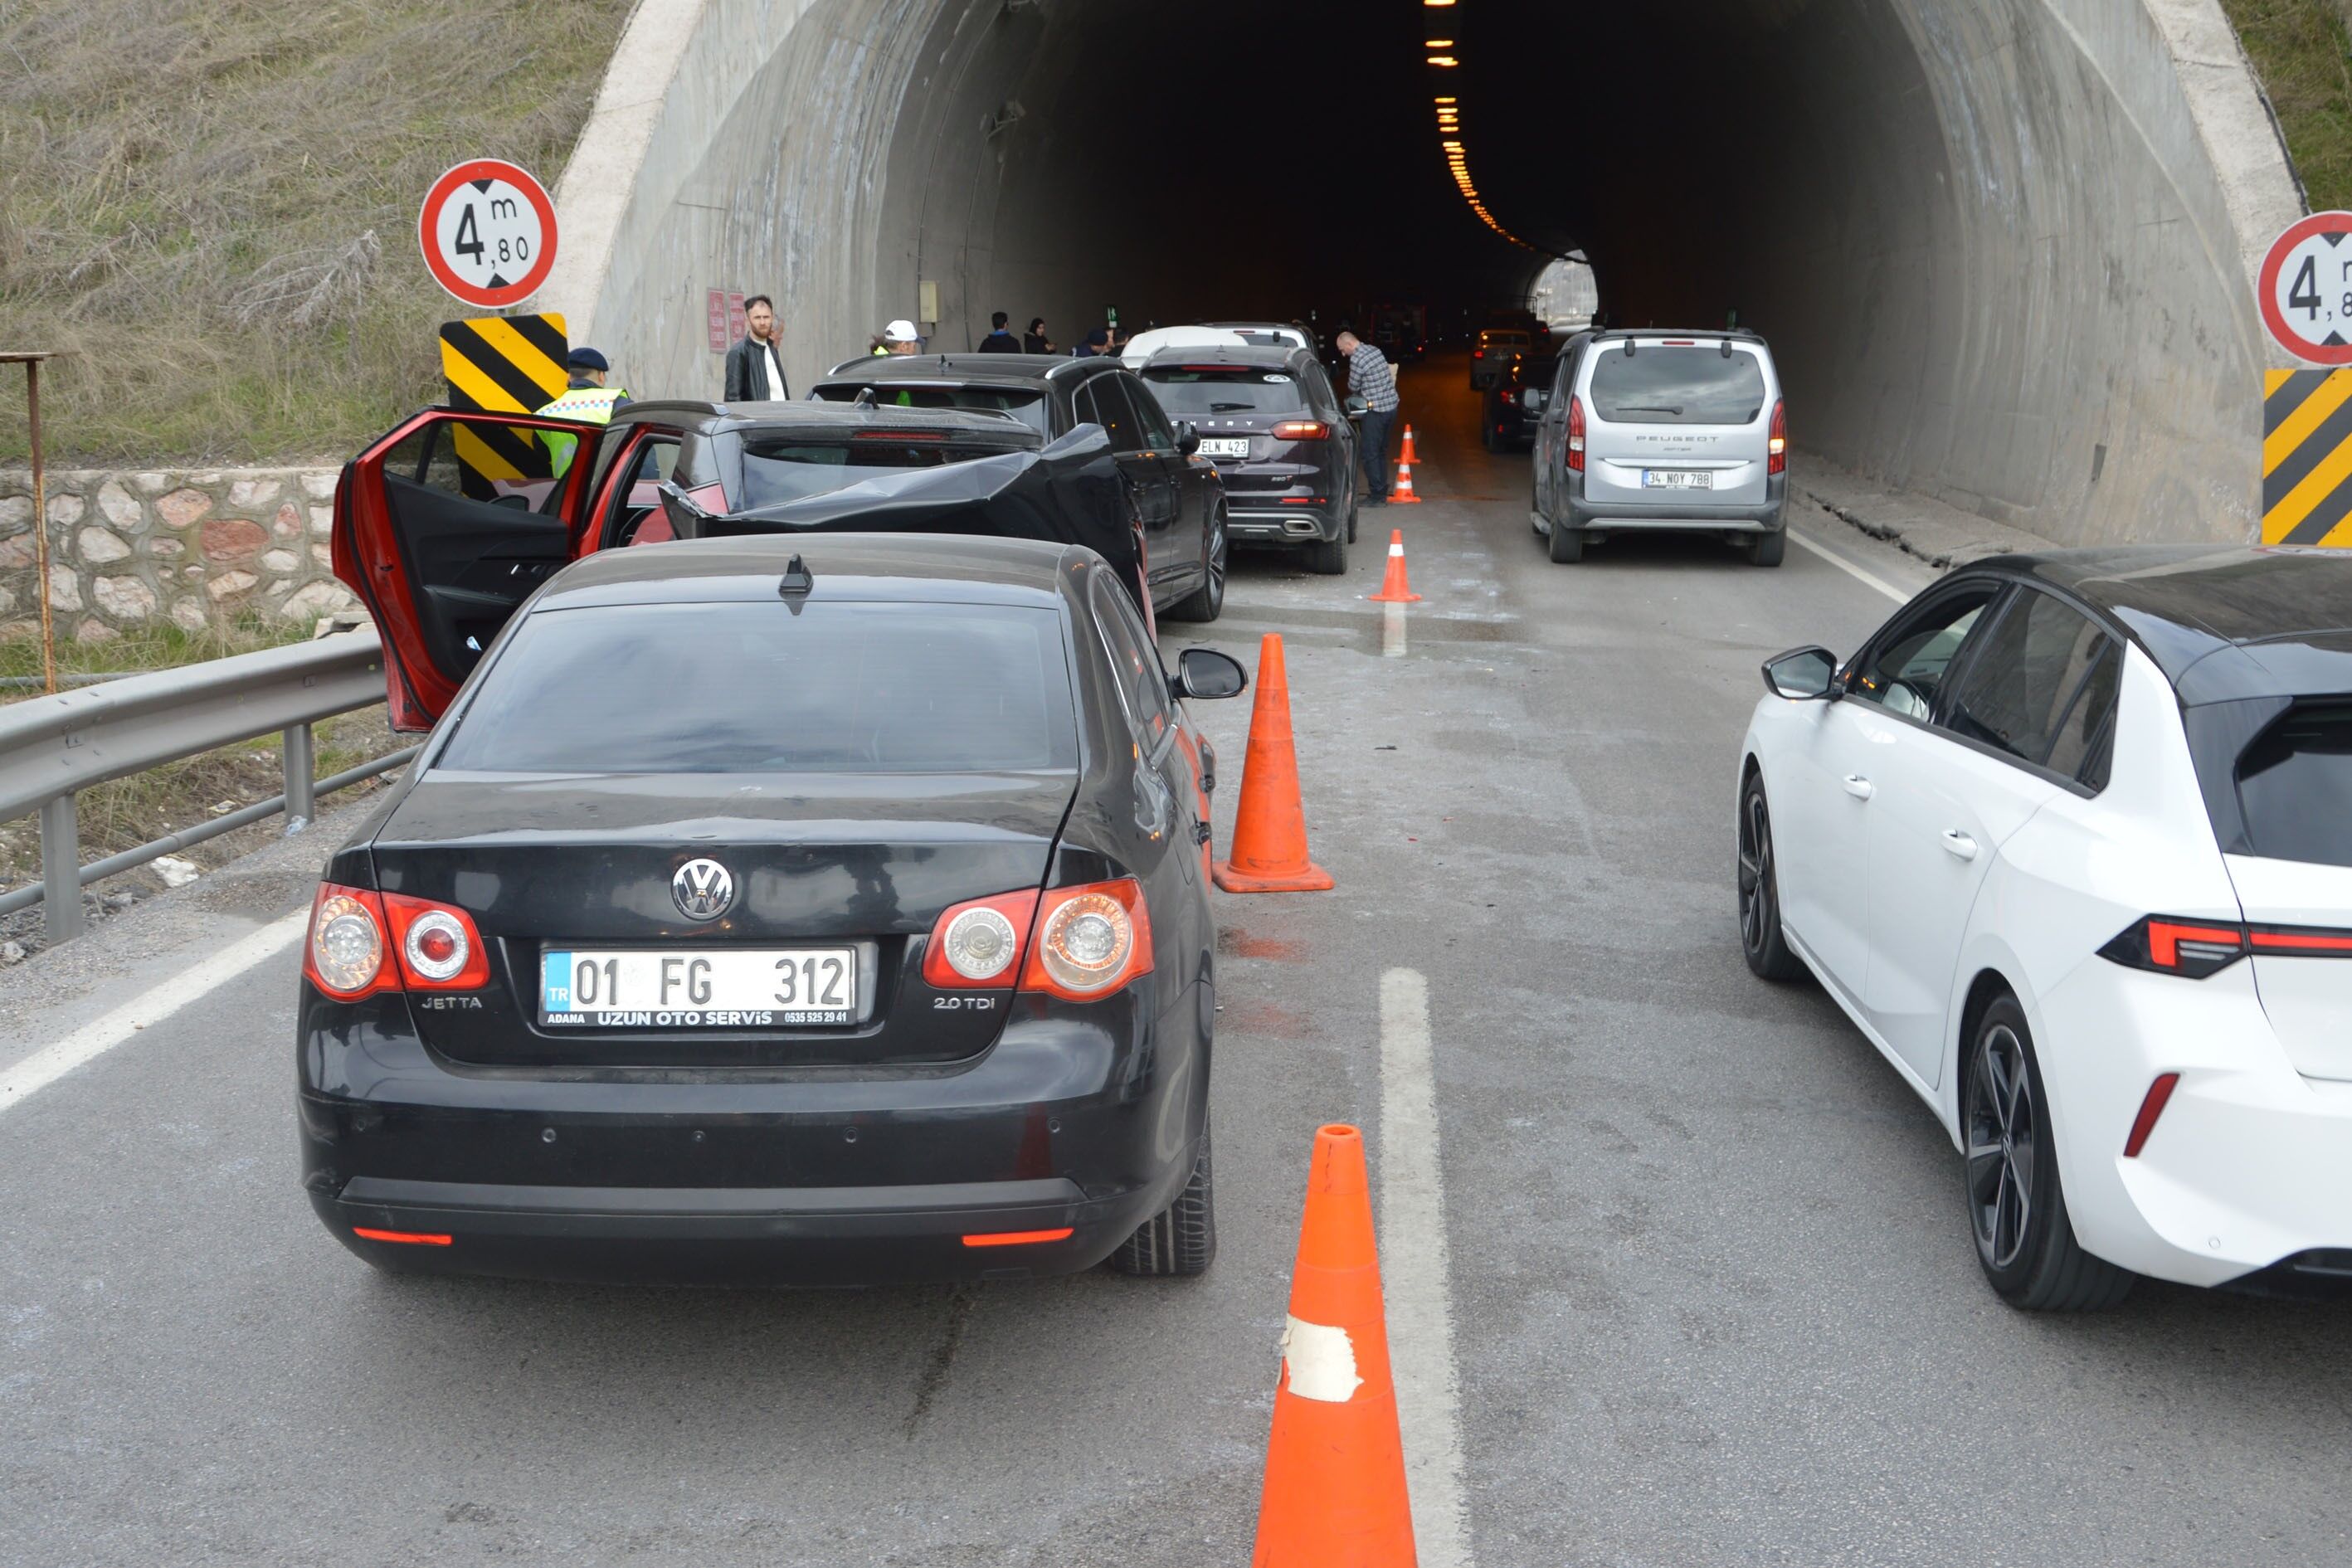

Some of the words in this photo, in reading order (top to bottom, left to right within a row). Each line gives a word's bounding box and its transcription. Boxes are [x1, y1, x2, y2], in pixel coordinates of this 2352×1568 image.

[491, 197, 517, 220] m
[1201, 441, 1220, 453] ELN
[1228, 441, 1247, 453] 423
[1649, 473, 1661, 484] 34
[1667, 473, 1686, 484] NOY
[674, 861, 731, 917] VW
[576, 957, 619, 1006] 01
[660, 957, 712, 1006] FG
[774, 957, 844, 1006] 312
[549, 987, 568, 1001] TR
[421, 996, 483, 1010] JETTA
[547, 1014, 586, 1024] ADANA
[597, 1011, 651, 1025] UZUN
[655, 1011, 701, 1025] OTO
[784, 1011, 806, 1023] 0535
[806, 1011, 823, 1022] 525
[824, 1011, 835, 1022] 29
[836, 1011, 847, 1022] 41
